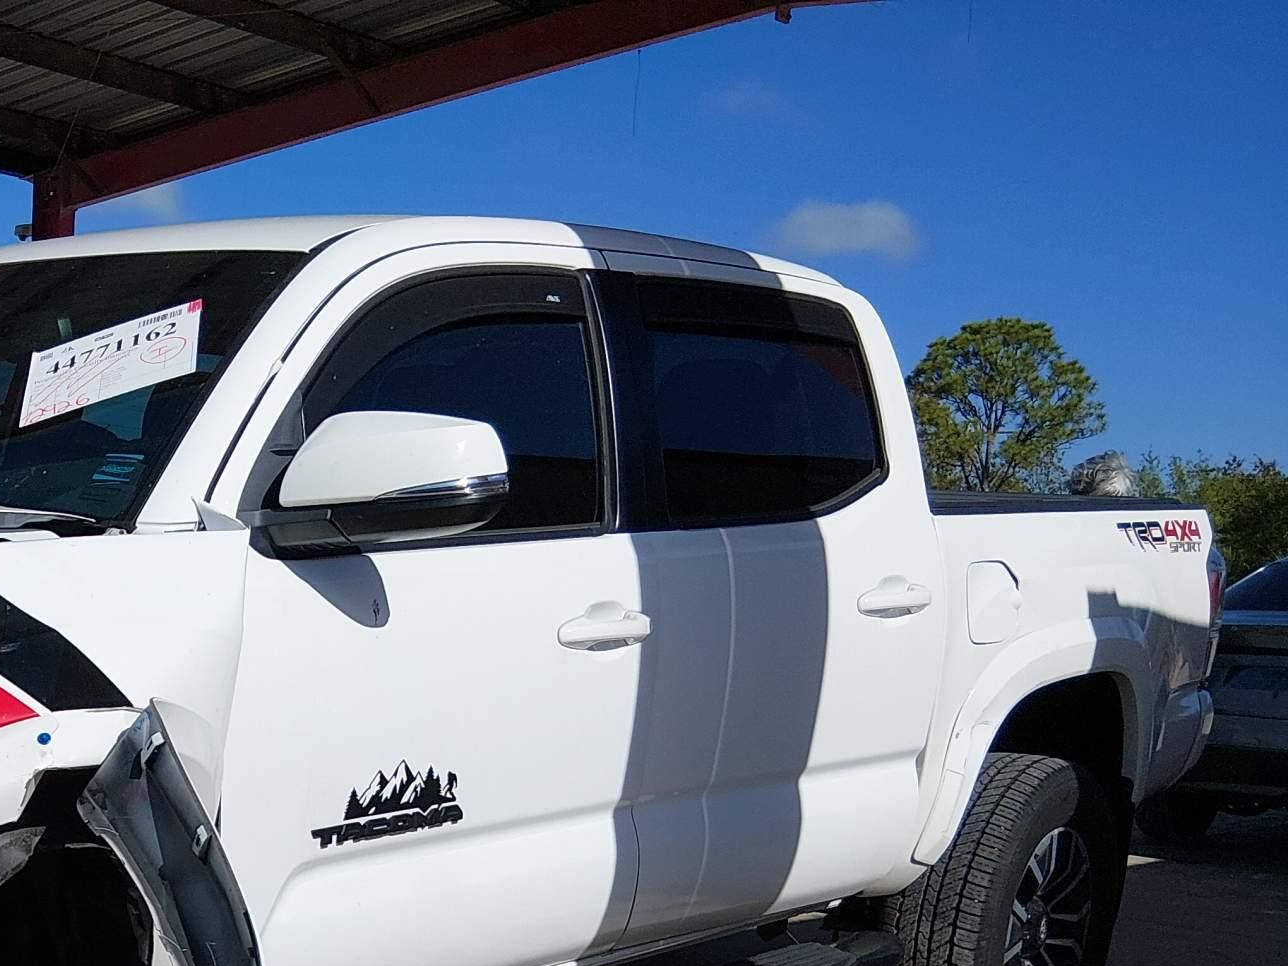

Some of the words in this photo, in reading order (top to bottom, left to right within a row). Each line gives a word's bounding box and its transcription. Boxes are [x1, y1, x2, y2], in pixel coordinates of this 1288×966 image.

[45, 321, 177, 375] 44771162
[1116, 521, 1167, 552] TRD
[1169, 541, 1202, 553] SPORT
[311, 803, 463, 849] TACOMA
